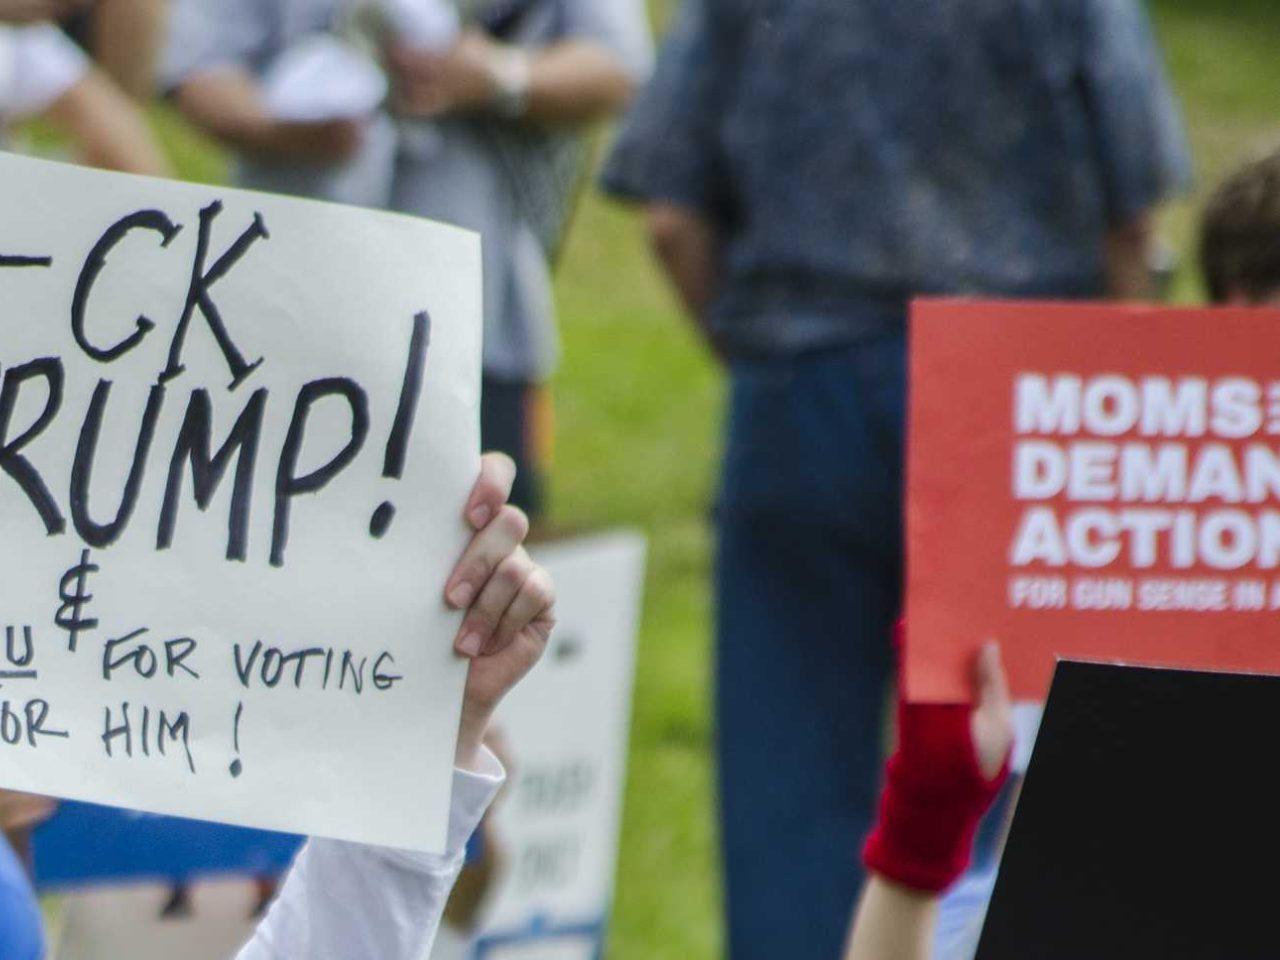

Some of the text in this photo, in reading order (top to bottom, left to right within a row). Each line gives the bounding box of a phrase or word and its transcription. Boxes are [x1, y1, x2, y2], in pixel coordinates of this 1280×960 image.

[1013, 373, 1263, 439] MOMS
[55, 548, 99, 652] &
[1010, 577, 1067, 611] FOR
[1073, 577, 1133, 611] GUN
[1234, 580, 1267, 612] IN
[102, 627, 200, 681] FOR
[233, 640, 403, 695] VOTING
